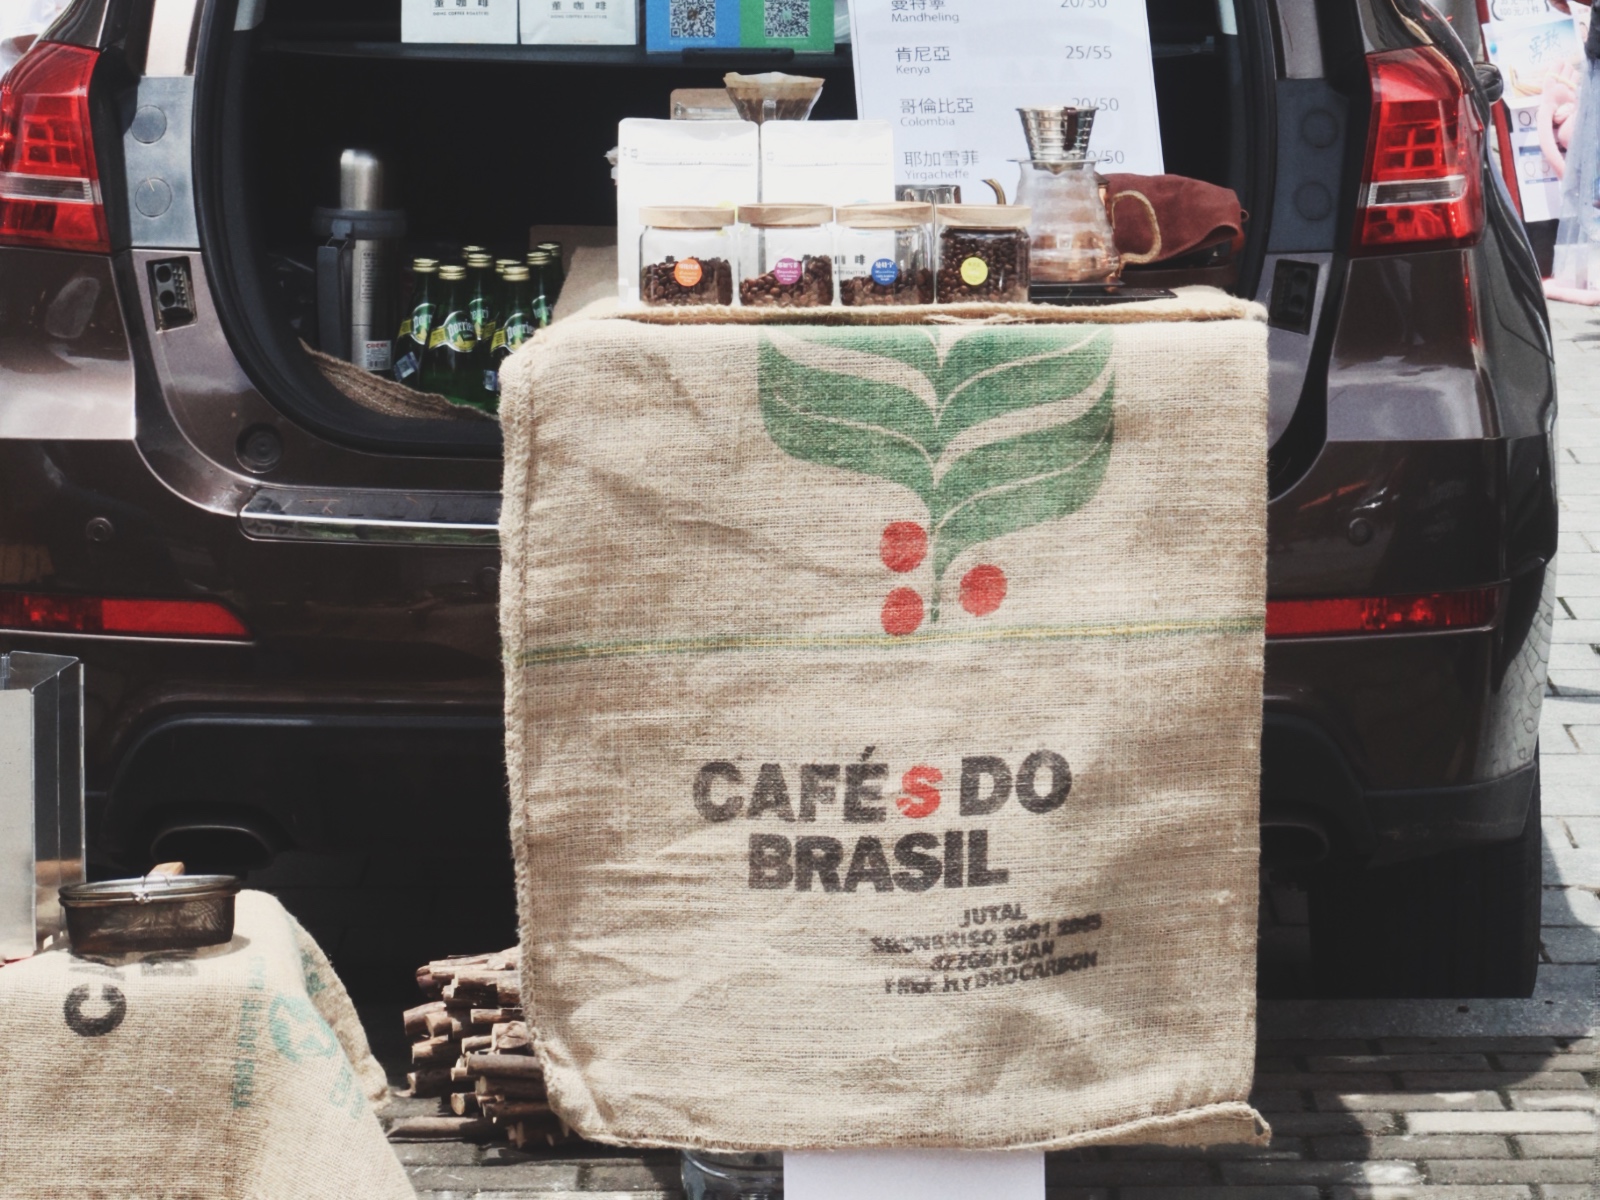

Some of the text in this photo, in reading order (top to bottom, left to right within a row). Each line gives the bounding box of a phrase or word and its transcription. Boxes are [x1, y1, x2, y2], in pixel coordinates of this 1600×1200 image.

[891, 12, 960, 25] Mandheling
[895, 46, 951, 63] 肯尼亞
[1065, 45, 1112, 60] 25/55
[896, 64, 931, 76] Kenya
[900, 98, 975, 114] 哥倫比亞
[900, 116, 956, 127] Colombia
[904, 150, 980, 167] 耶加雪菲
[905, 170, 970, 182] Yirgacheffe
[960, 750, 1072, 815] DO
[747, 830, 1009, 892] BRASIL
[959, 903, 1027, 928] JUTAL
